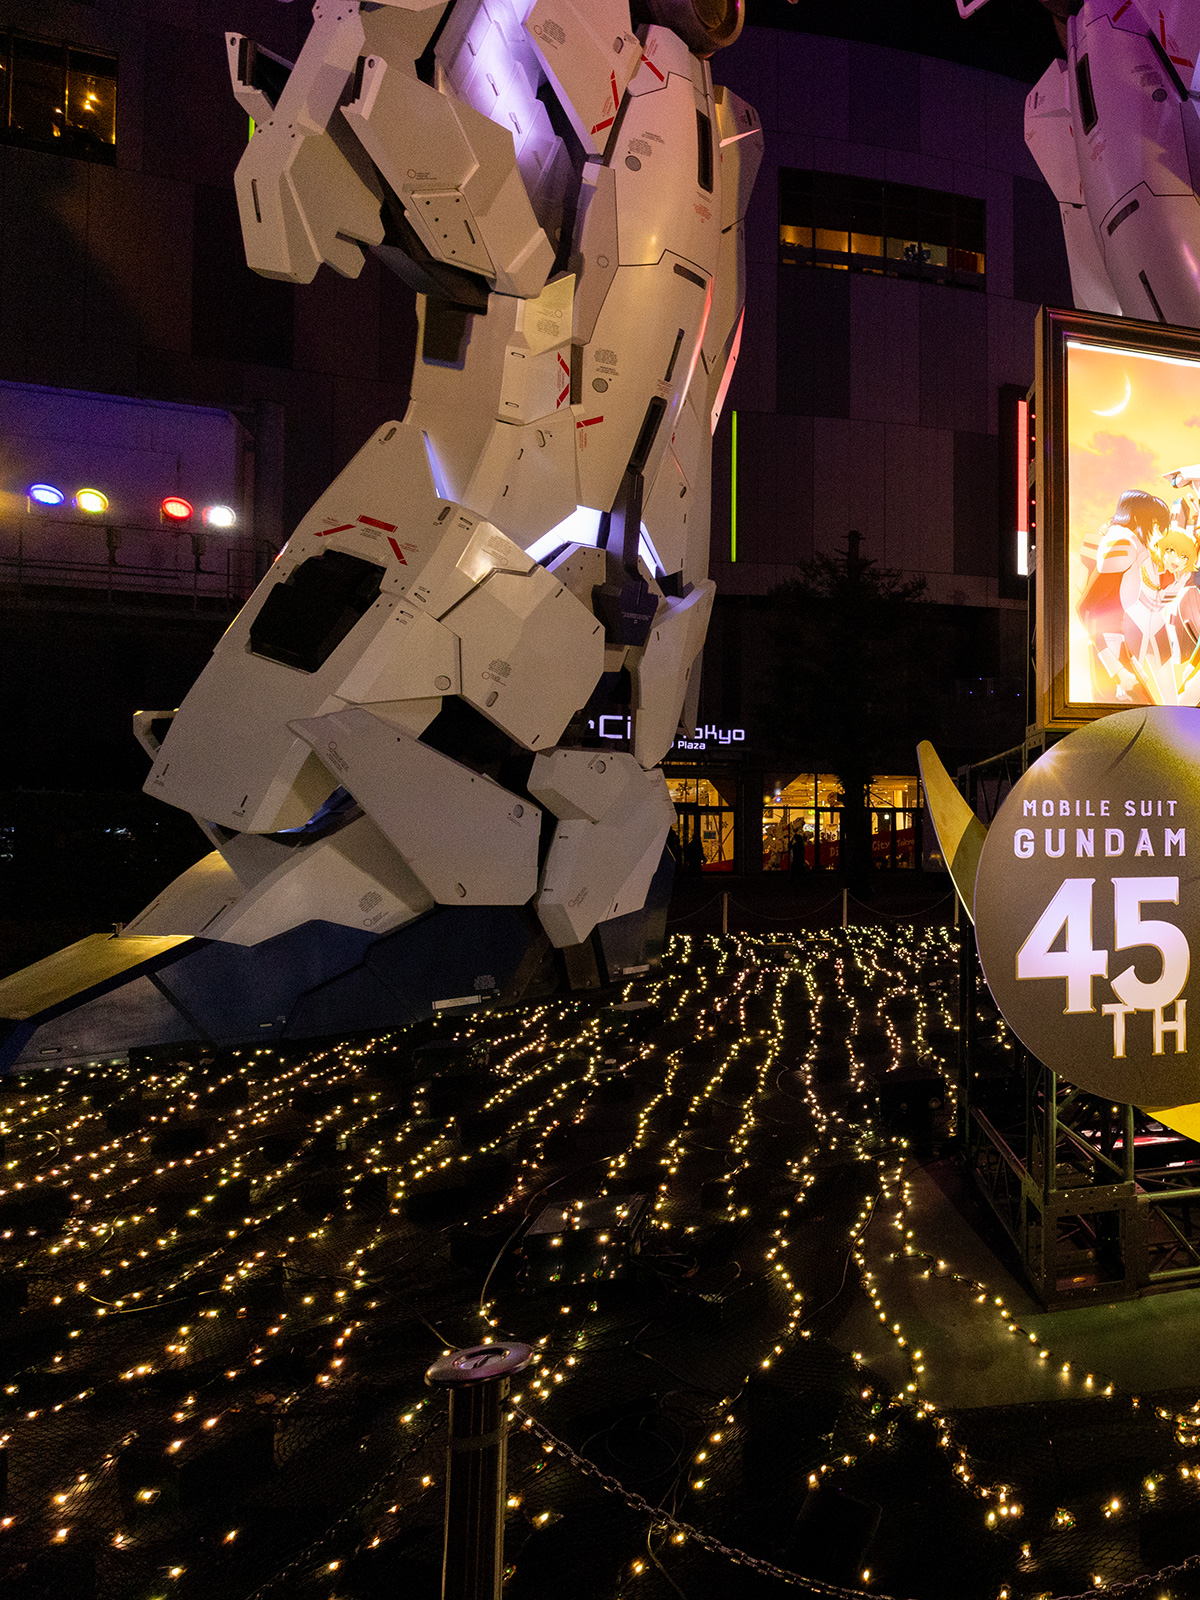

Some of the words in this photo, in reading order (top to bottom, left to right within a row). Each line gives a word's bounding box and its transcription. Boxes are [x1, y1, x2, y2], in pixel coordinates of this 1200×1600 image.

[677, 740, 706, 750] Plaza
[1023, 799, 1110, 817] MOBILE
[1124, 799, 1178, 817] SUIT
[1013, 827, 1187, 859] GUNDAM
[1015, 876, 1191, 1014] 45
